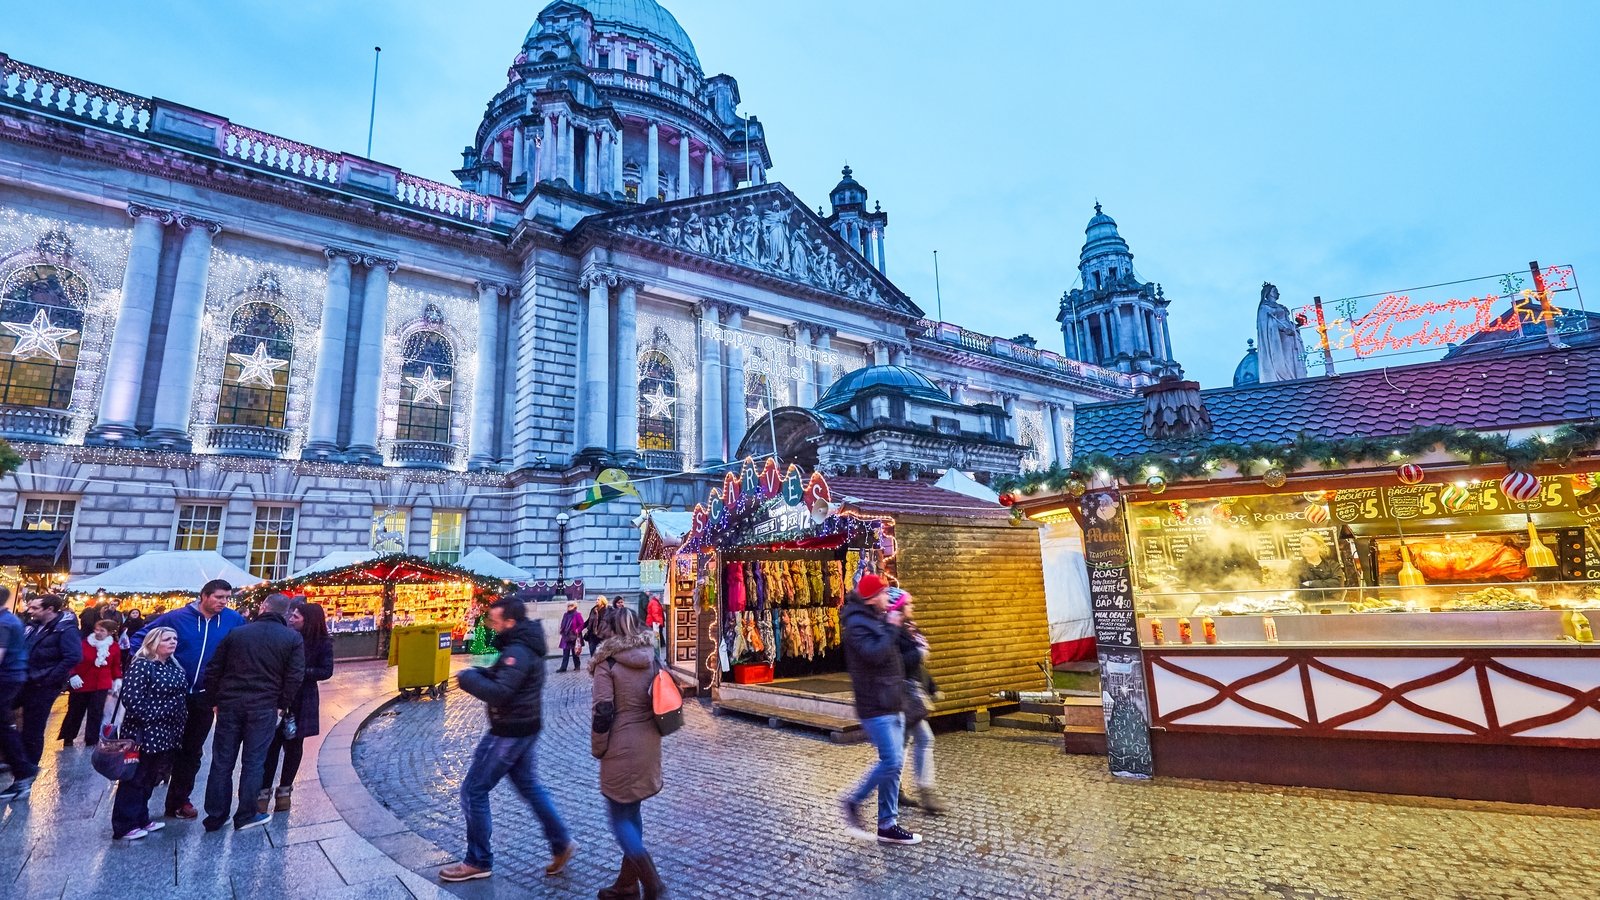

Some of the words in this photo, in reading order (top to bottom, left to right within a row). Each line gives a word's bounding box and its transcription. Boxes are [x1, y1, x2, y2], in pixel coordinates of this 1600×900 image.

[1351, 293, 1499, 327] Merry
[1351, 311, 1521, 356] Christmas
[701, 320, 755, 351] Happy
[762, 335, 839, 366] Christmas
[748, 354, 807, 380] Belfast
[1334, 489, 1377, 501] BAGUETTE
[1388, 485, 1433, 497] BAGUETTE
[1478, 488, 1498, 510] £5
[1541, 483, 1562, 507] £5
[1360, 498, 1378, 518] £5
[1420, 491, 1436, 514] £5
[1087, 527, 1122, 543] Menu
[1089, 548, 1124, 559] TRADITIONAL
[1092, 567, 1126, 579] ROAST
[1117, 578, 1128, 593] £5
[1095, 599, 1112, 608] BAP
[1118, 631, 1132, 645] £5
